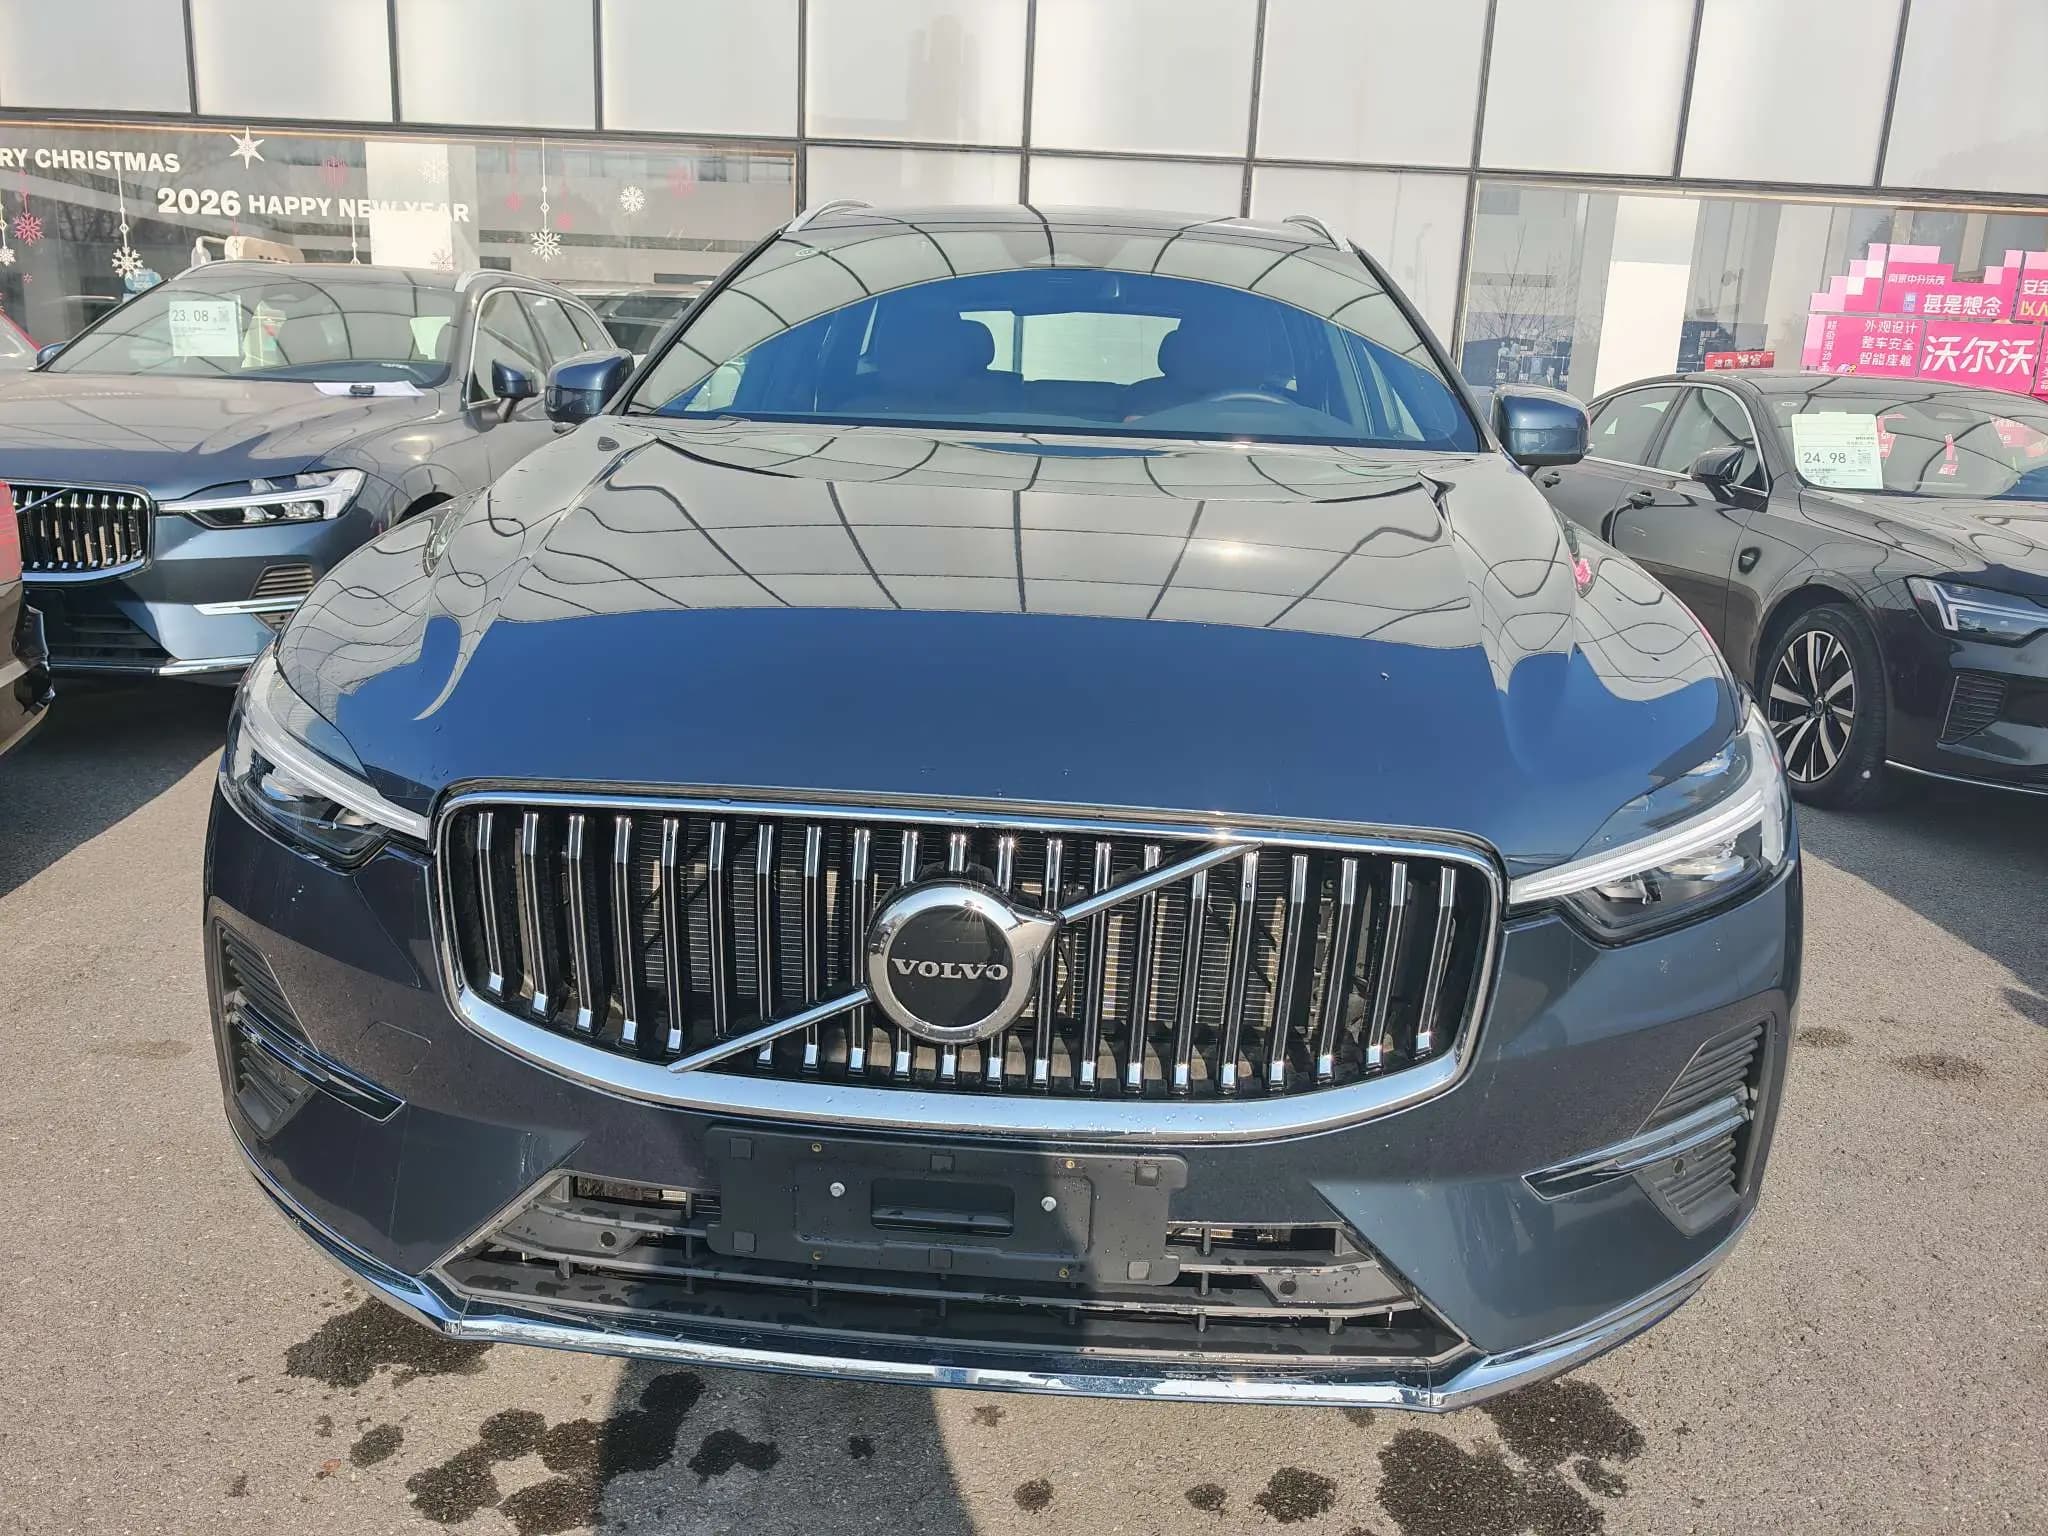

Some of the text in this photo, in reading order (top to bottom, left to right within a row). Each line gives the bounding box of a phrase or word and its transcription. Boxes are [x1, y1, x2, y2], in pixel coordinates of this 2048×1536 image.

[35, 149, 181, 173] CHRISTMAS
[157, 187, 241, 217] 2026
[248, 195, 332, 217] HAPPY
[1923, 293, 2003, 317] 甚是想念
[1864, 319, 1918, 335] 外观设计
[1861, 335, 1915, 351] 整车安全
[1859, 351, 1913, 367] 智能座舱
[1922, 335, 2036, 376] 沃尔沃
[1803, 451, 1848, 465] 24.98
[891, 958, 1009, 981] VOLVO
